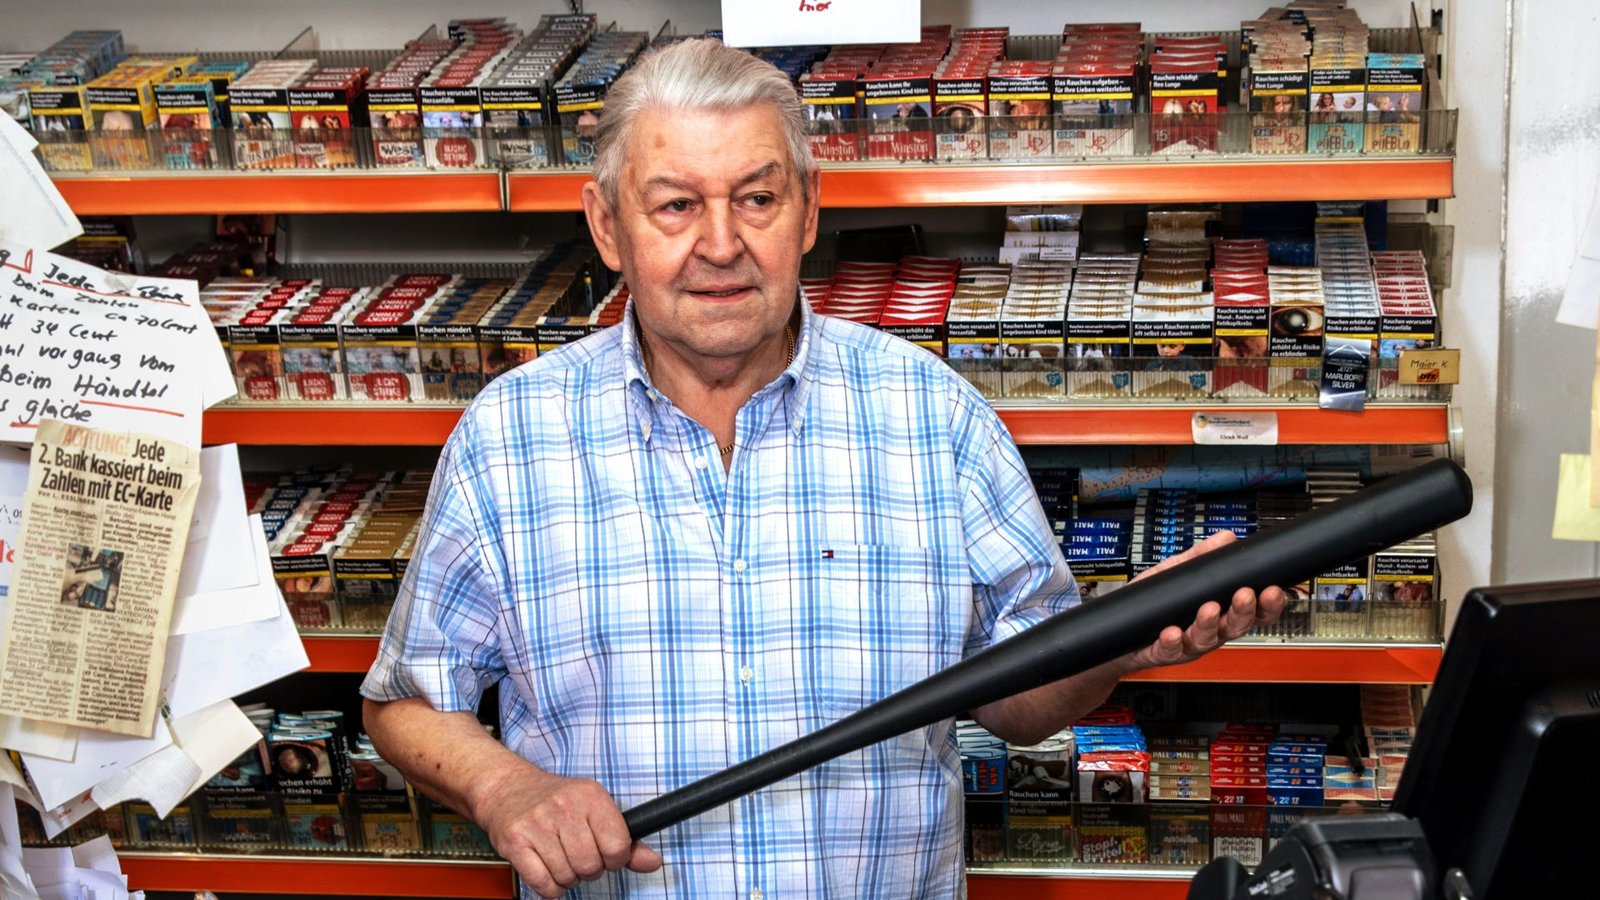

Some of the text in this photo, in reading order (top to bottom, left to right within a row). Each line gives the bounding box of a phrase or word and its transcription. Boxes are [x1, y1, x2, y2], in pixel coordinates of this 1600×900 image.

[1176, 74, 1198, 82] schädigt
[1279, 74, 1303, 84] schädigt
[312, 92, 334, 100] schädigt
[867, 89, 900, 97] ungeborenes
[1316, 135, 1354, 150] PUEBLO
[1372, 135, 1410, 149] PUEBLO
[818, 144, 854, 156] Winston
[891, 142, 928, 154] Winston
[31, 319, 60, 336] 34
[68, 324, 118, 342] Cent
[420, 326, 472, 334] Rauchen mindert
[1280, 350, 1307, 358] erblinden
[1326, 372, 1364, 382] MARLBORO
[1332, 380, 1354, 389] SILVER
[132, 438, 166, 464] Jede
[38, 443, 183, 490] 2. Bank kassiert beim
[40, 468, 86, 499] Zahlen
[88, 478, 112, 502] mit
[114, 481, 174, 512] EC-Karte
[1102, 521, 1120, 529] PALL
[1068, 547, 1115, 556] PALL MALL
[306, 778, 332, 786] erhöht
[1009, 790, 1059, 798] Rauchen kann
